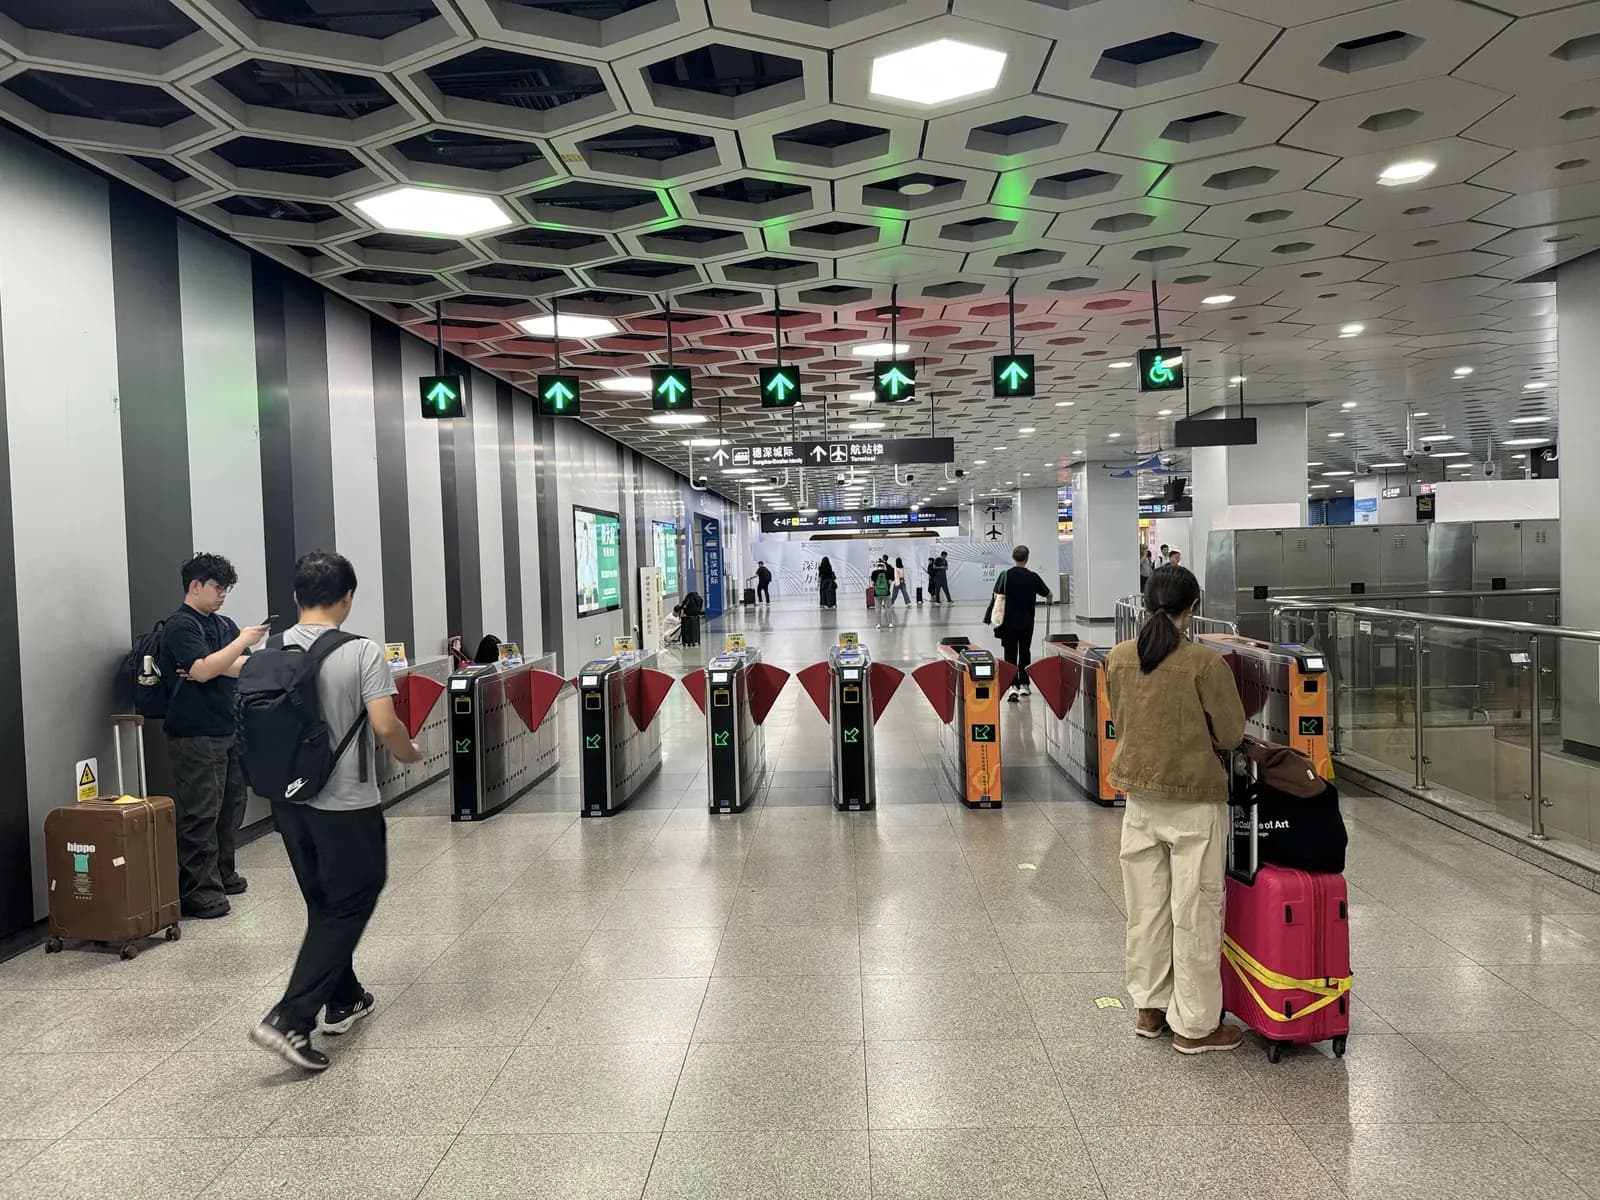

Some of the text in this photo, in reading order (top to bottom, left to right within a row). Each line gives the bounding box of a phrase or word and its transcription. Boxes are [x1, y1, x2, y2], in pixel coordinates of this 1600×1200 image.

[752, 446, 793, 459] 穗深城际
[850, 443, 884, 455] 航站楼
[781, 518, 791, 526] 4F
[817, 517, 828, 525] 2F
[862, 515, 872, 523] 1F
[1275, 819, 1290, 829] Art
[66, 841, 96, 854] hippo
